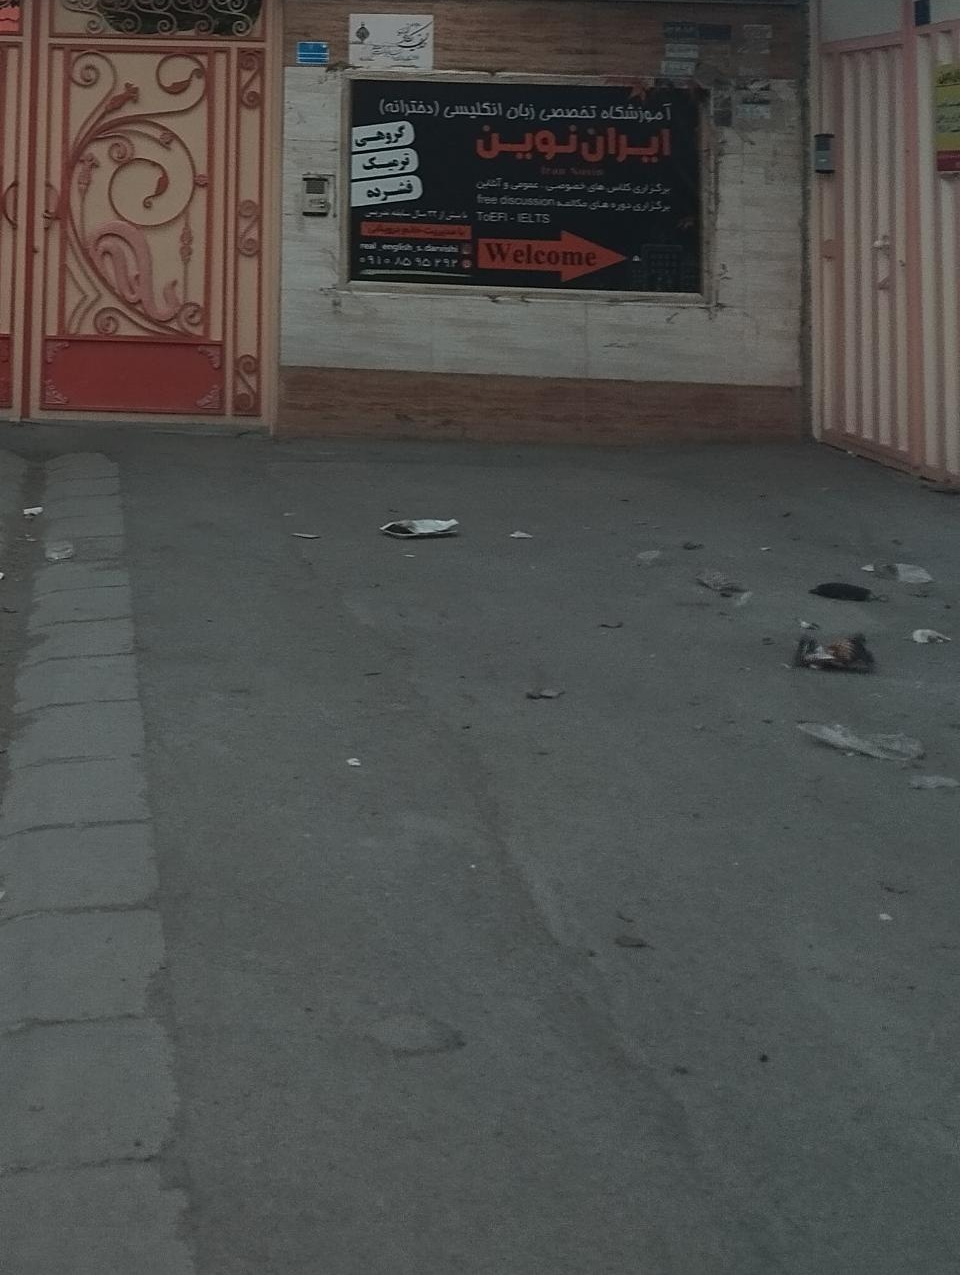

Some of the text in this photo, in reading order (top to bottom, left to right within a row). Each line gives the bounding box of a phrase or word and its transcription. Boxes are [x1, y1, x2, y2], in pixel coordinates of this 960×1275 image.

[379, 99, 440, 116] (دخترانه)
[506, 103, 536, 120] زبان
[538, 105, 597, 121] تخصصی
[600, 103, 673, 123] آموزشگاه
[354, 125, 406, 147] گروهی
[475, 124, 672, 163] ایران نوین
[366, 179, 414, 202] فشرده
[477, 194, 498, 205] free
[500, 195, 555, 206] discussion
[517, 213, 550, 224] IELTS
[485, 242, 598, 266] Welcome
